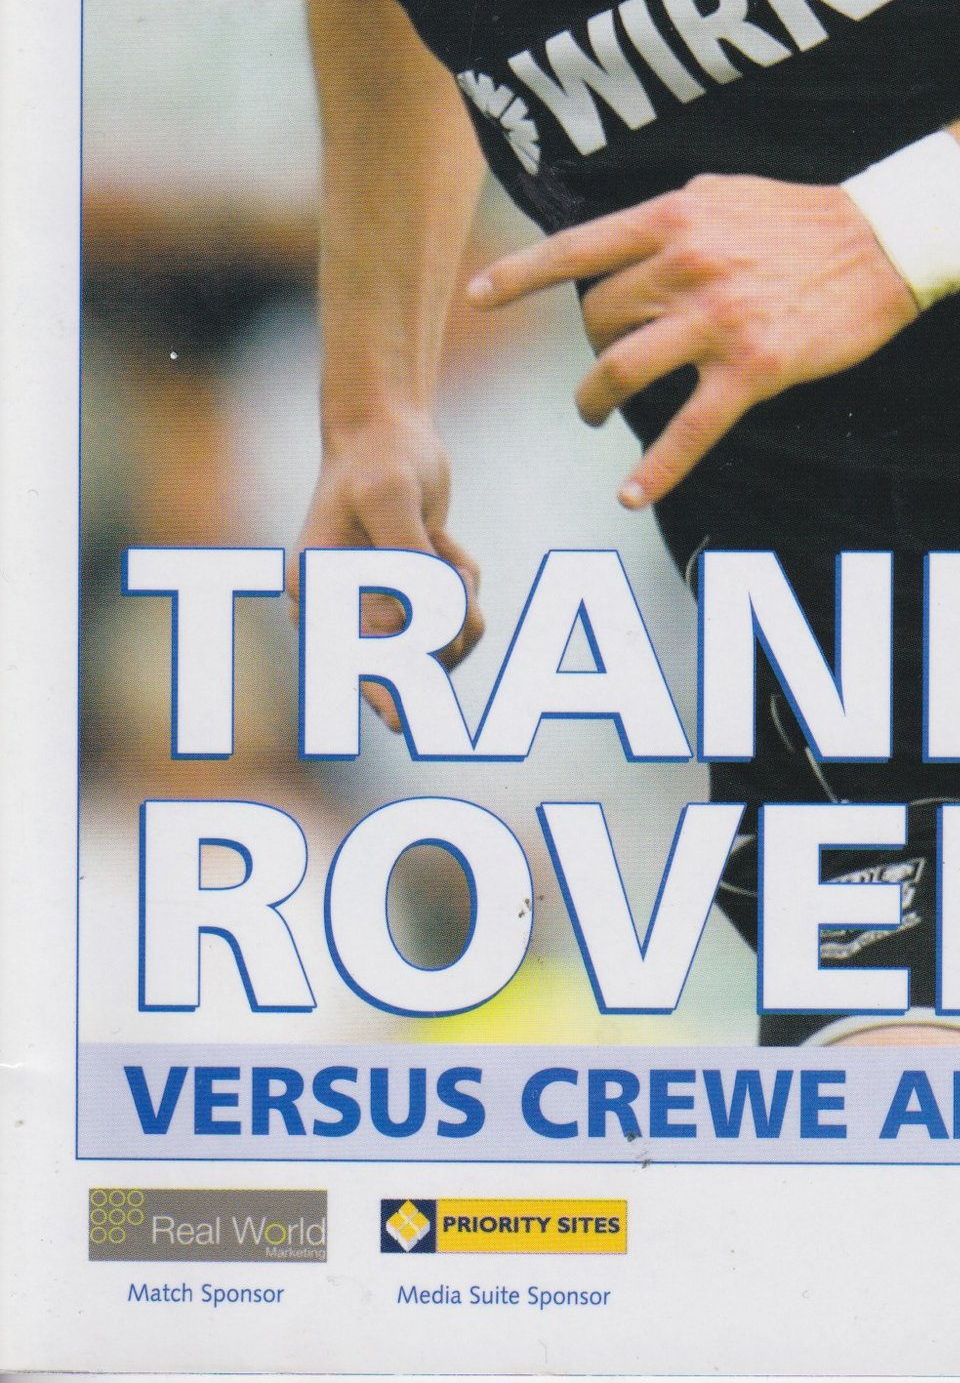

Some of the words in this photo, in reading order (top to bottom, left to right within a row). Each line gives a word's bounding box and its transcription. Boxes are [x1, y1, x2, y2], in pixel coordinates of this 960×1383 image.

[123, 1065, 486, 1139] VERSUS
[520, 1067, 848, 1143] CREWE
[151, 1215, 222, 1245] Real
[231, 1212, 326, 1246] World
[442, 1216, 549, 1234] PRIORITY
[557, 1216, 620, 1235] SITES
[265, 1247, 326, 1260] Marketing
[127, 1282, 193, 1303] Match
[201, 1283, 285, 1309] Sponsor
[397, 1284, 463, 1305] Media
[469, 1285, 520, 1305] Suite
[527, 1285, 611, 1311] Sponsor
